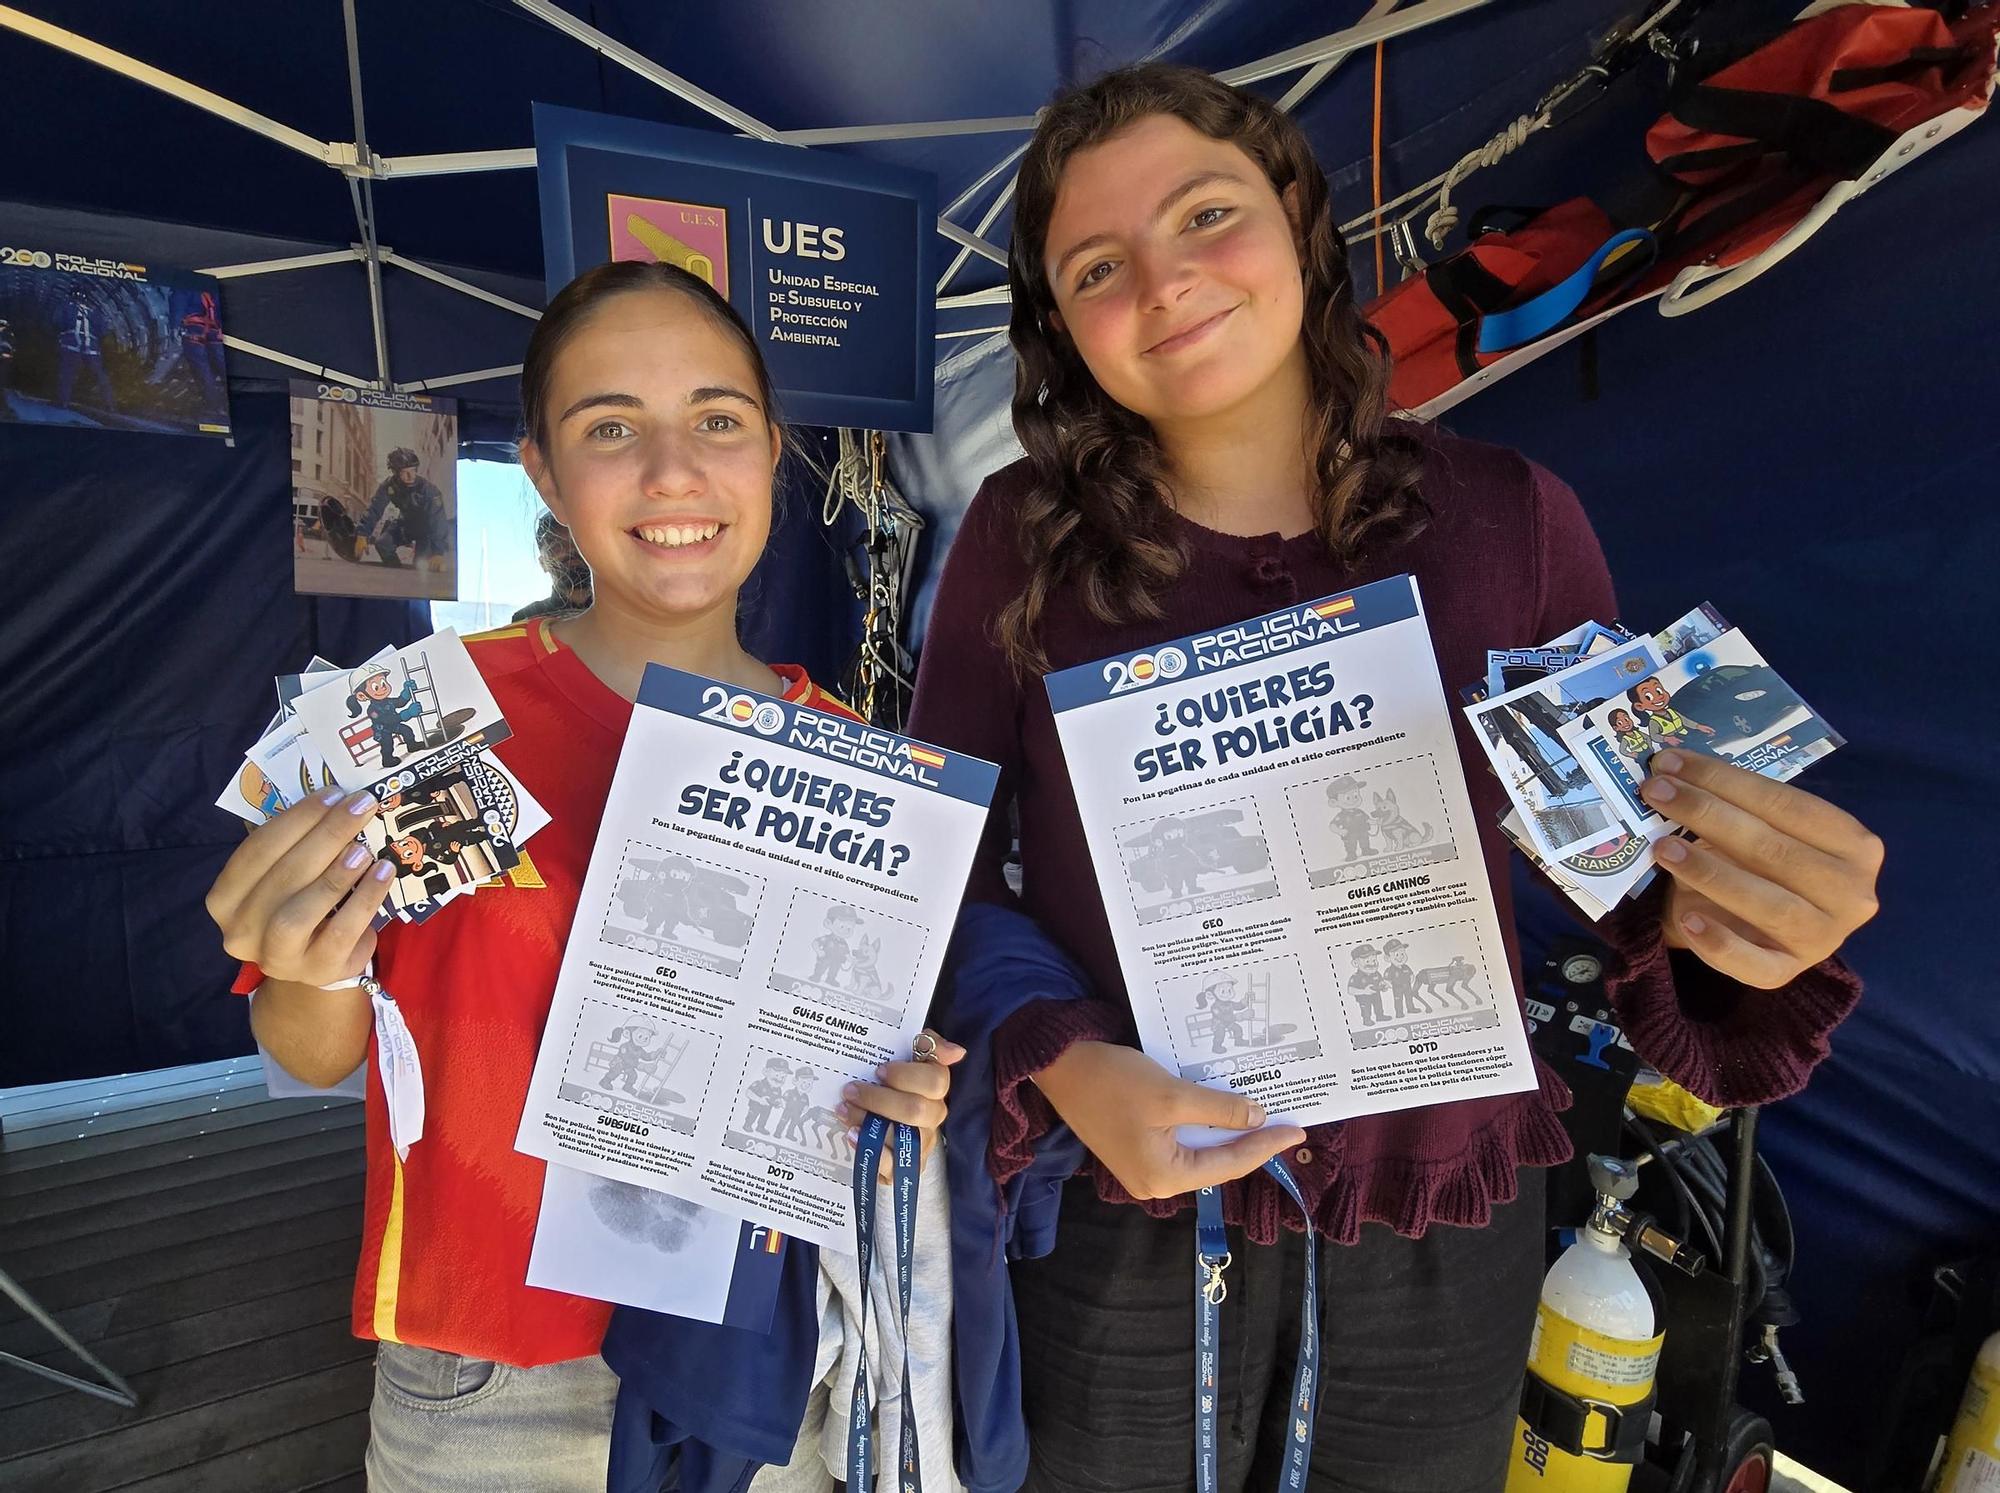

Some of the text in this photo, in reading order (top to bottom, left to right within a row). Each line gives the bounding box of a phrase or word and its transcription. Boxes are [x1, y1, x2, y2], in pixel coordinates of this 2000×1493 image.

[680, 212, 719, 227] U.E.S.
[763, 218, 846, 261] UES
[56, 263, 148, 282] NACIONAL
[769, 292, 786, 303] DE
[854, 302, 862, 312] Y
[361, 397, 432, 411] NACIONAL
[1196, 618, 1360, 671] NACIONAL
[419, 742, 489, 779] NACIONAL
[789, 729, 939, 787] NACIONAL
[1122, 732, 1405, 804] Pon las pegatinas de cada unidad en el sitio correspondiente
[1134, 738, 1207, 783] SER
[470, 756, 496, 807] NACION
[678, 784, 751, 830] SER
[651, 817, 918, 903] Pon las pegatinas de cada unidad en el sitio correspondiente
[1315, 905, 1349, 916] Trabajan
[1363, 896, 1394, 907] perritos
[1394, 893, 1408, 901] que
[1409, 889, 1430, 897] saben
[1430, 885, 1446, 893] oler
[1447, 881, 1467, 889] cosas
[1360, 907, 1380, 915] como
[1380, 902, 1405, 911] drogas
[1202, 917, 1223, 930] GEO
[1313, 924, 1338, 934] perros
[1415, 902, 1446, 912] también
[1446, 896, 1478, 907] policías.
[655, 966, 677, 979] GEO
[1408, 1041, 1438, 1055] DOTD
[1391, 1060, 1413, 1068] hacen
[1418, 1063, 1447, 1073] policías
[1447, 1057, 1485, 1067] funcionen
[1485, 1054, 1507, 1062] súper
[1229, 1069, 1281, 1089] SUBSUELO
[1366, 1087, 1399, 1096] moderna
[1441, 1077, 1459, 1086] pelis
[1472, 1072, 1500, 1080] futuro.
[1369, 1079, 1398, 1088] Ayudan
[1427, 1070, 1452, 1080] policía
[1452, 1067, 1474, 1075] tenga
[597, 1115, 649, 1137] SUBSUELO
[767, 1164, 794, 1181] DOTD
